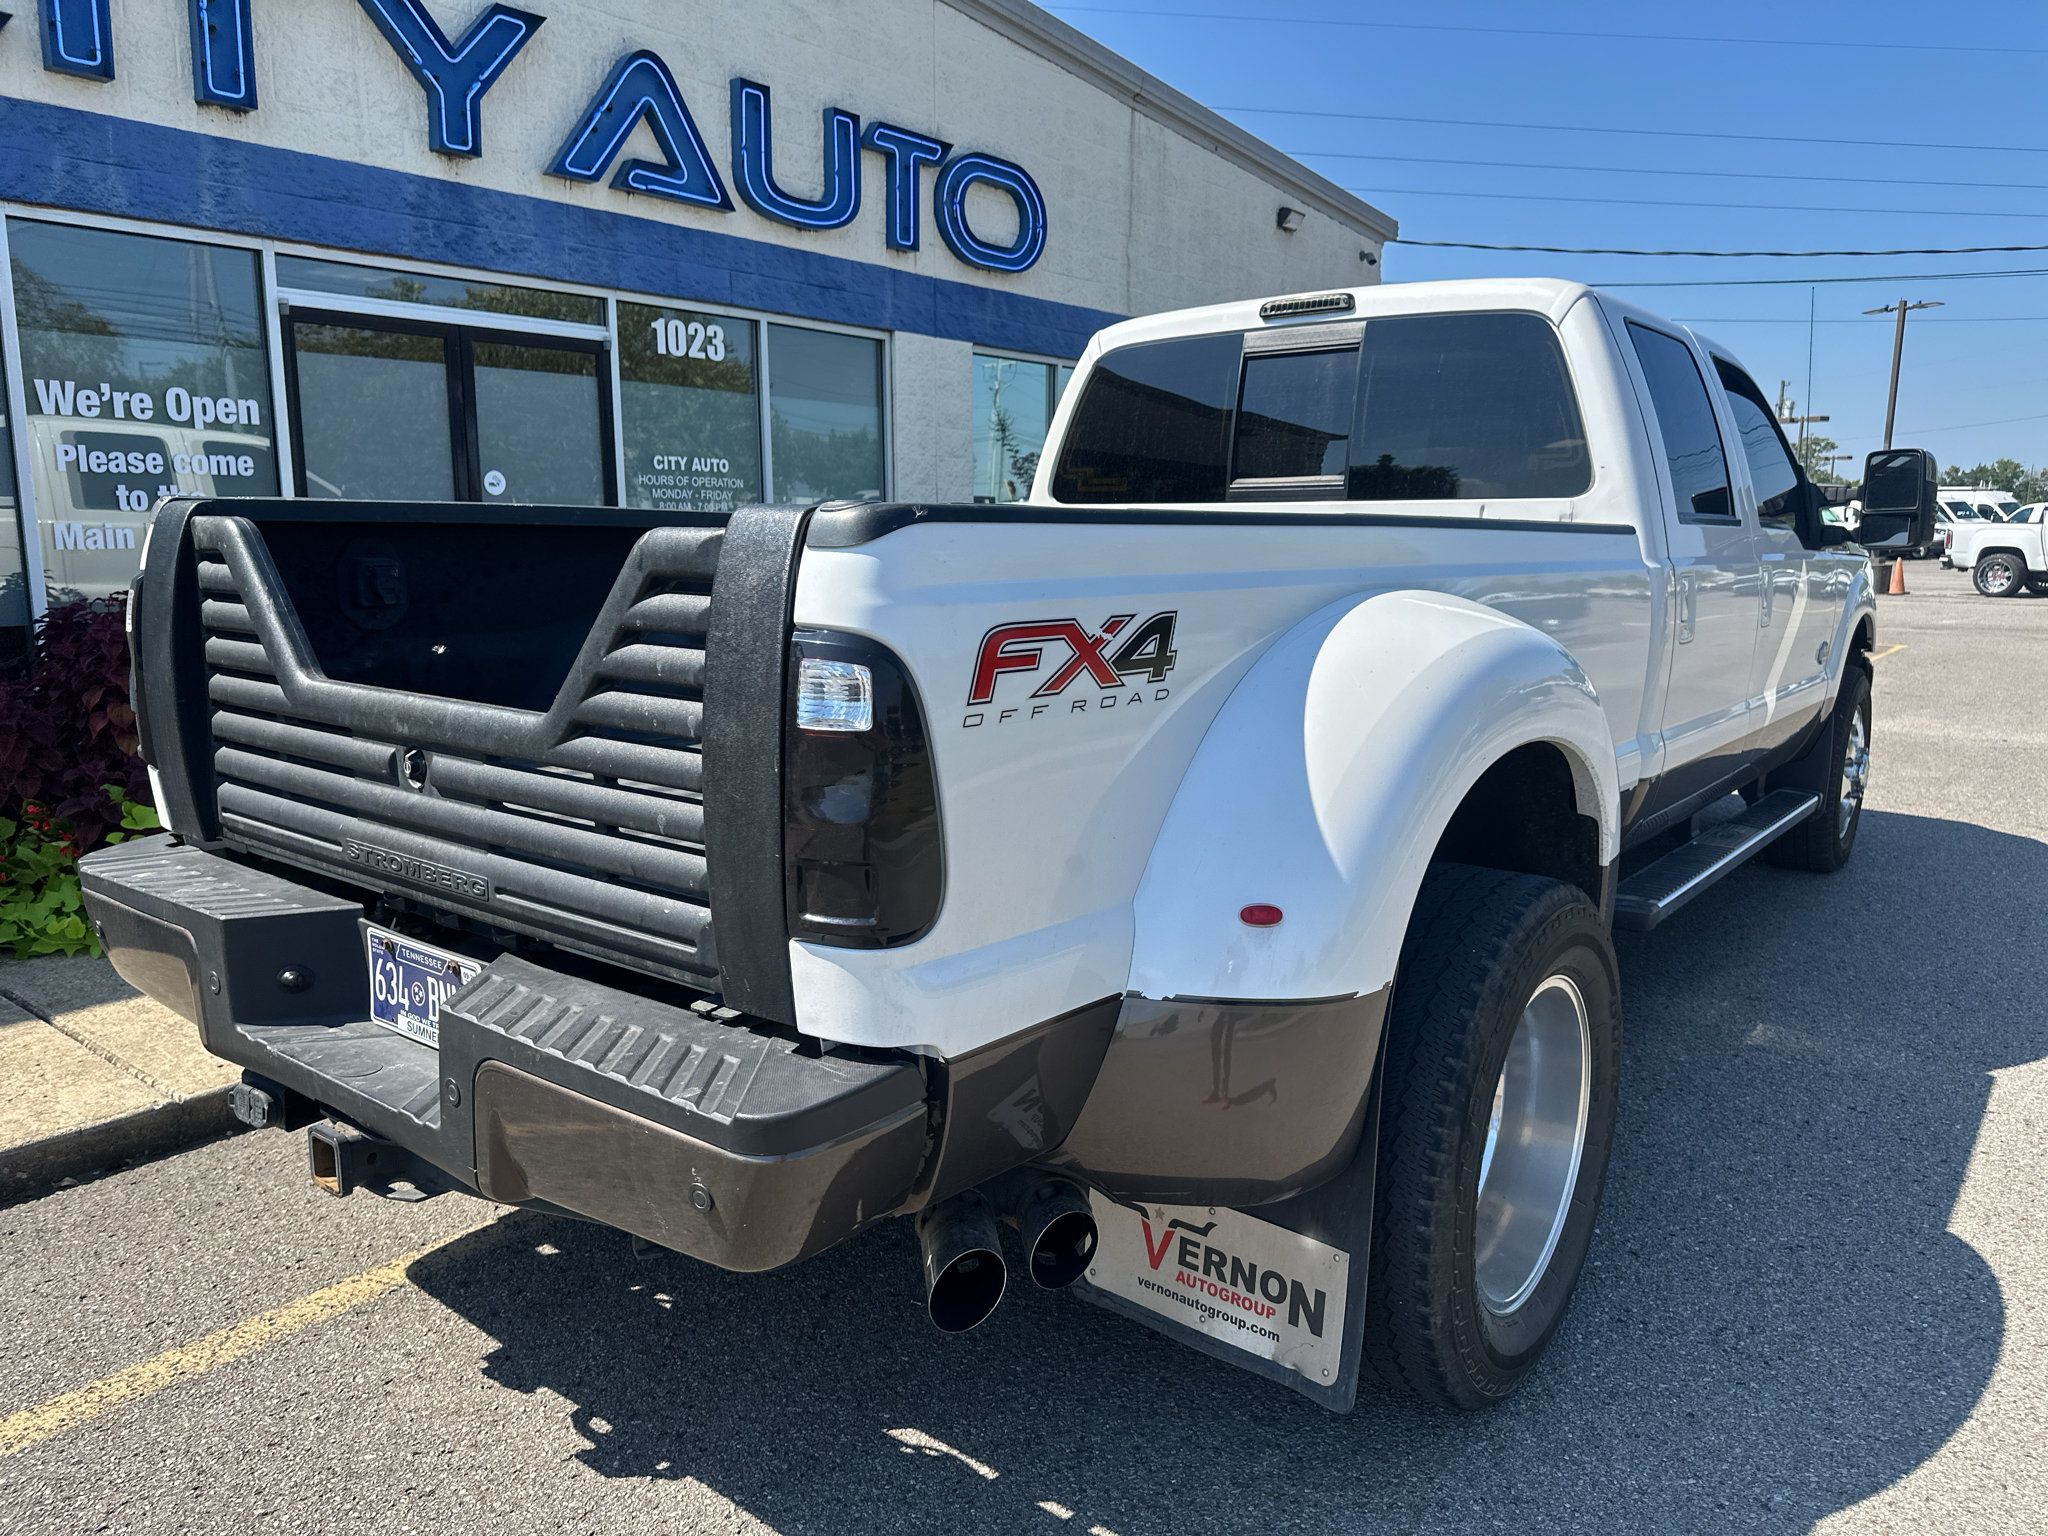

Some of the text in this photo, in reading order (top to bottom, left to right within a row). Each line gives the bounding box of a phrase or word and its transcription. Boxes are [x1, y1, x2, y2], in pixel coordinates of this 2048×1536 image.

[0, 0, 1047, 273] TY AUTO
[650, 317, 725, 362] 1023
[33, 378, 260, 429] We’re Open
[55, 443, 255, 477] Please come
[653, 454, 729, 473] CITY AUTO
[115, 484, 149, 512] to
[639, 474, 744, 489] HOURS OF OPERATION
[652, 488, 693, 500] MONDAY
[701, 490, 733, 500] FRIDAY
[53, 522, 136, 551] Main
[966, 610, 1178, 706] FX4
[962, 688, 1171, 728] OFF ROAD
[347, 842, 487, 897] STROMBERG
[402, 948, 442, 969] TENNESSEE
[375, 958, 457, 1022] 634 BN
[406, 1021, 438, 1043] SUMNE
[1141, 1219, 1327, 1339] VERNON
[1175, 1270, 1276, 1320] AUTOGROUP
[1137, 1276, 1280, 1343] vernonautogroup.com
